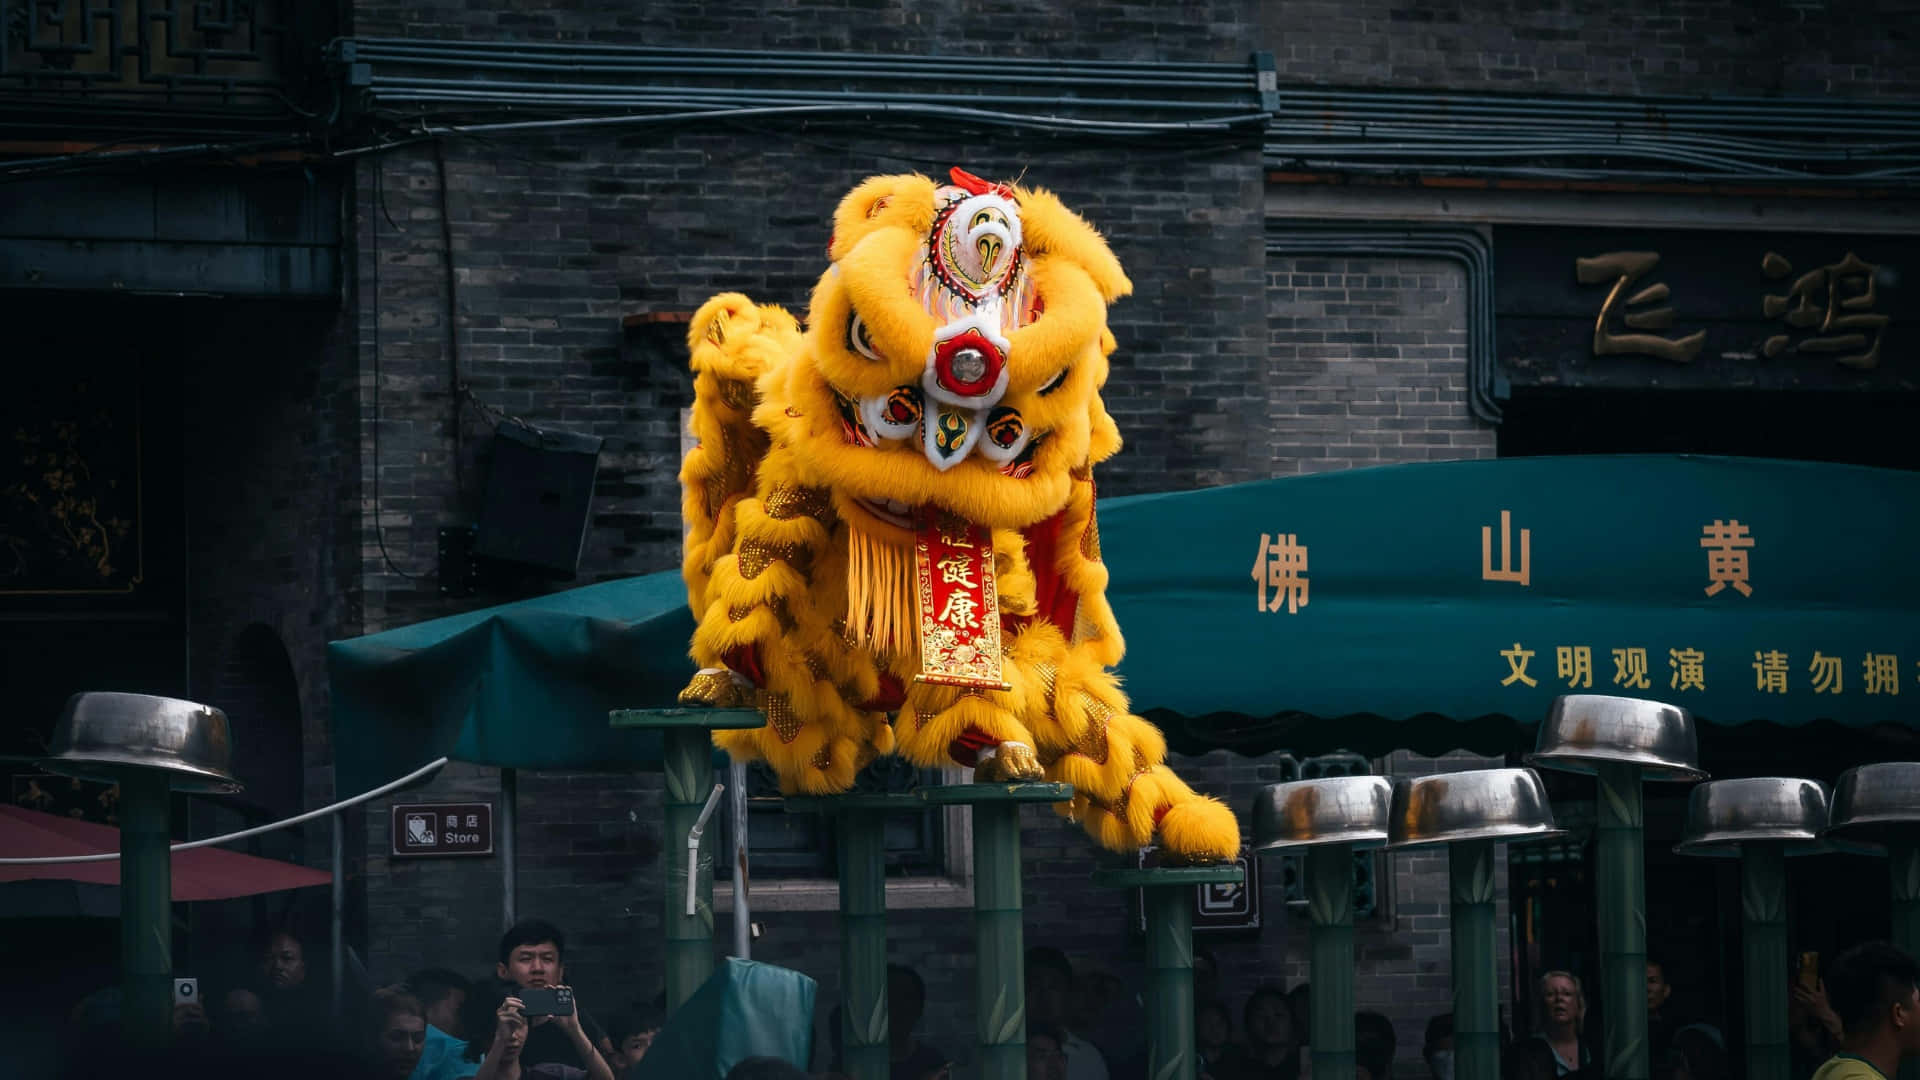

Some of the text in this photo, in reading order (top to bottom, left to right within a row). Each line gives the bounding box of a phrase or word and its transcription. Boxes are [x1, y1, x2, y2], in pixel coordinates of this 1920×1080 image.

[1500, 643, 1920, 696] 文明观演 请勿拥
[446, 815, 478, 828] 商店
[446, 832, 479, 844] Store
